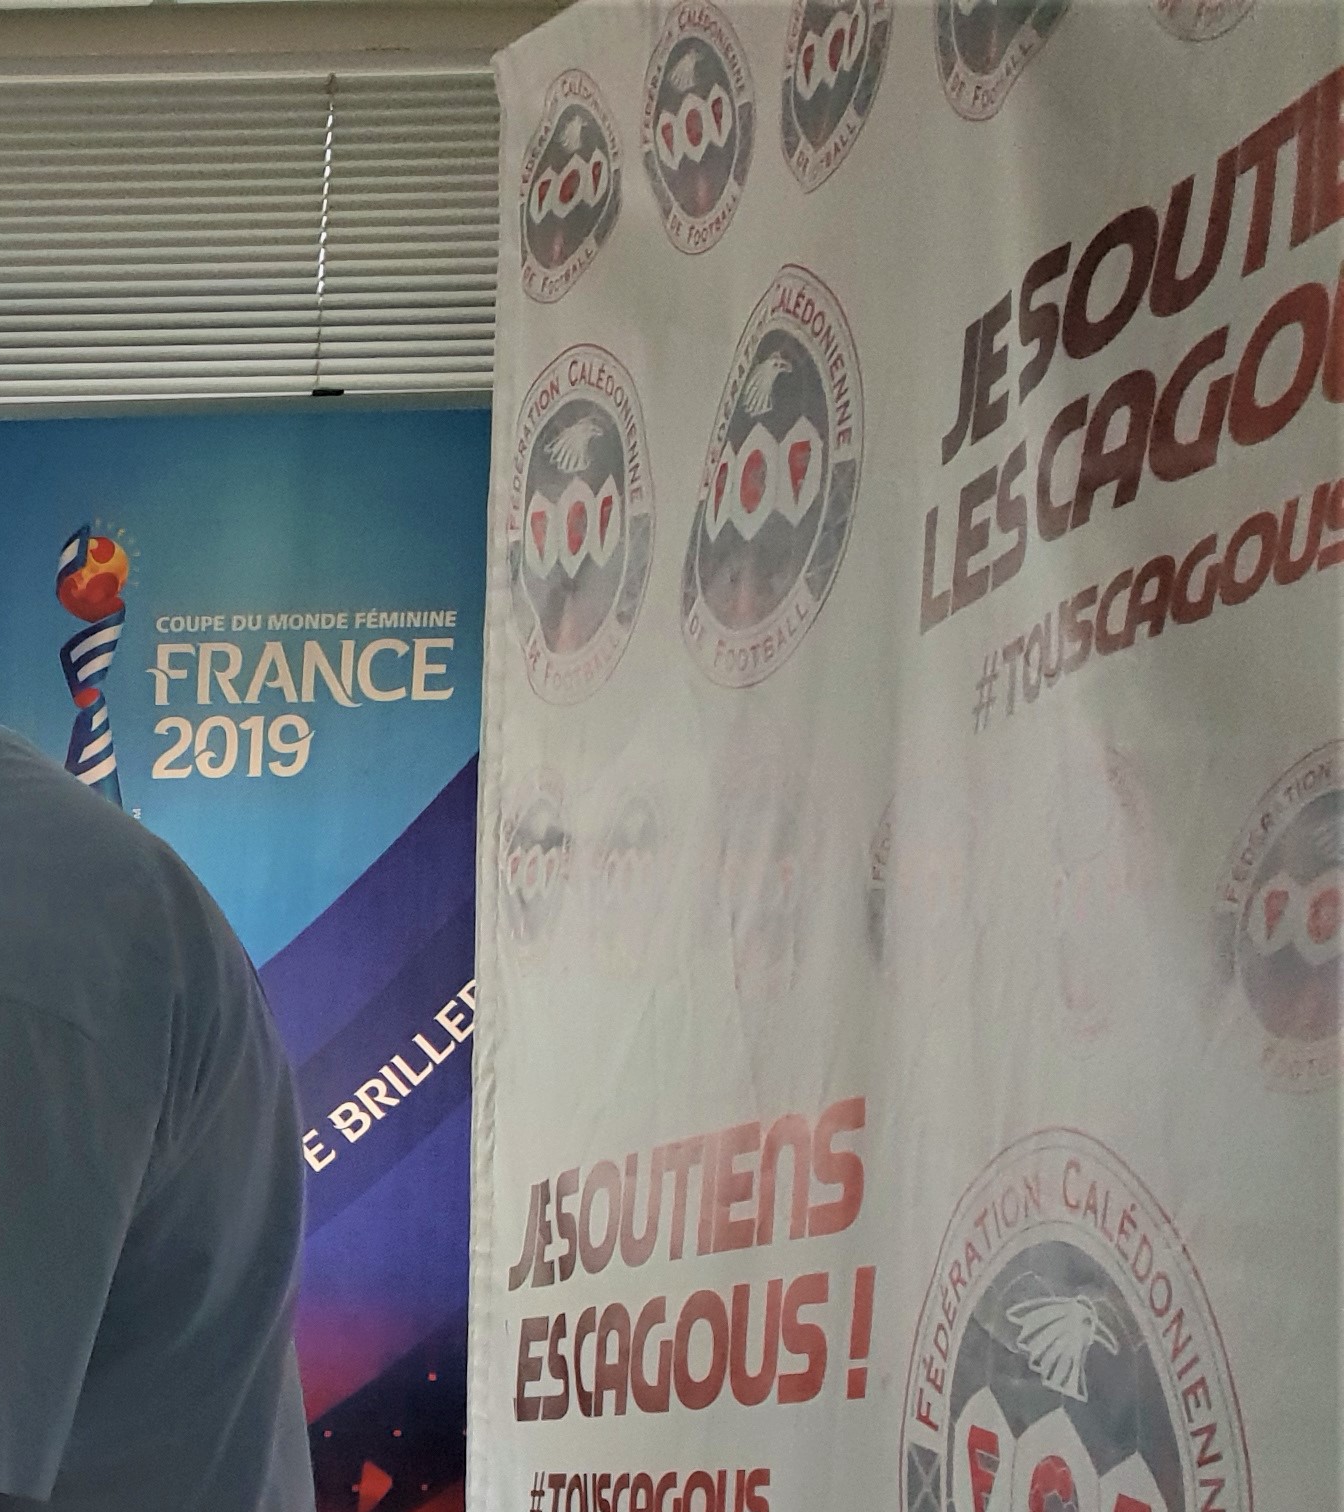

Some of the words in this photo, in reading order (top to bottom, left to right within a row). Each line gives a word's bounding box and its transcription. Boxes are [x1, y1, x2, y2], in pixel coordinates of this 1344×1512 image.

[156, 614, 225, 633] COUPE
[231, 614, 261, 632] DU
[268, 612, 348, 631] MONDE
[355, 608, 458, 629] FÉMININE
[146, 637, 454, 708] FRANCE
[152, 714, 316, 779] 2019
[916, 1175, 1041, 1431] FÉDÉRATION
